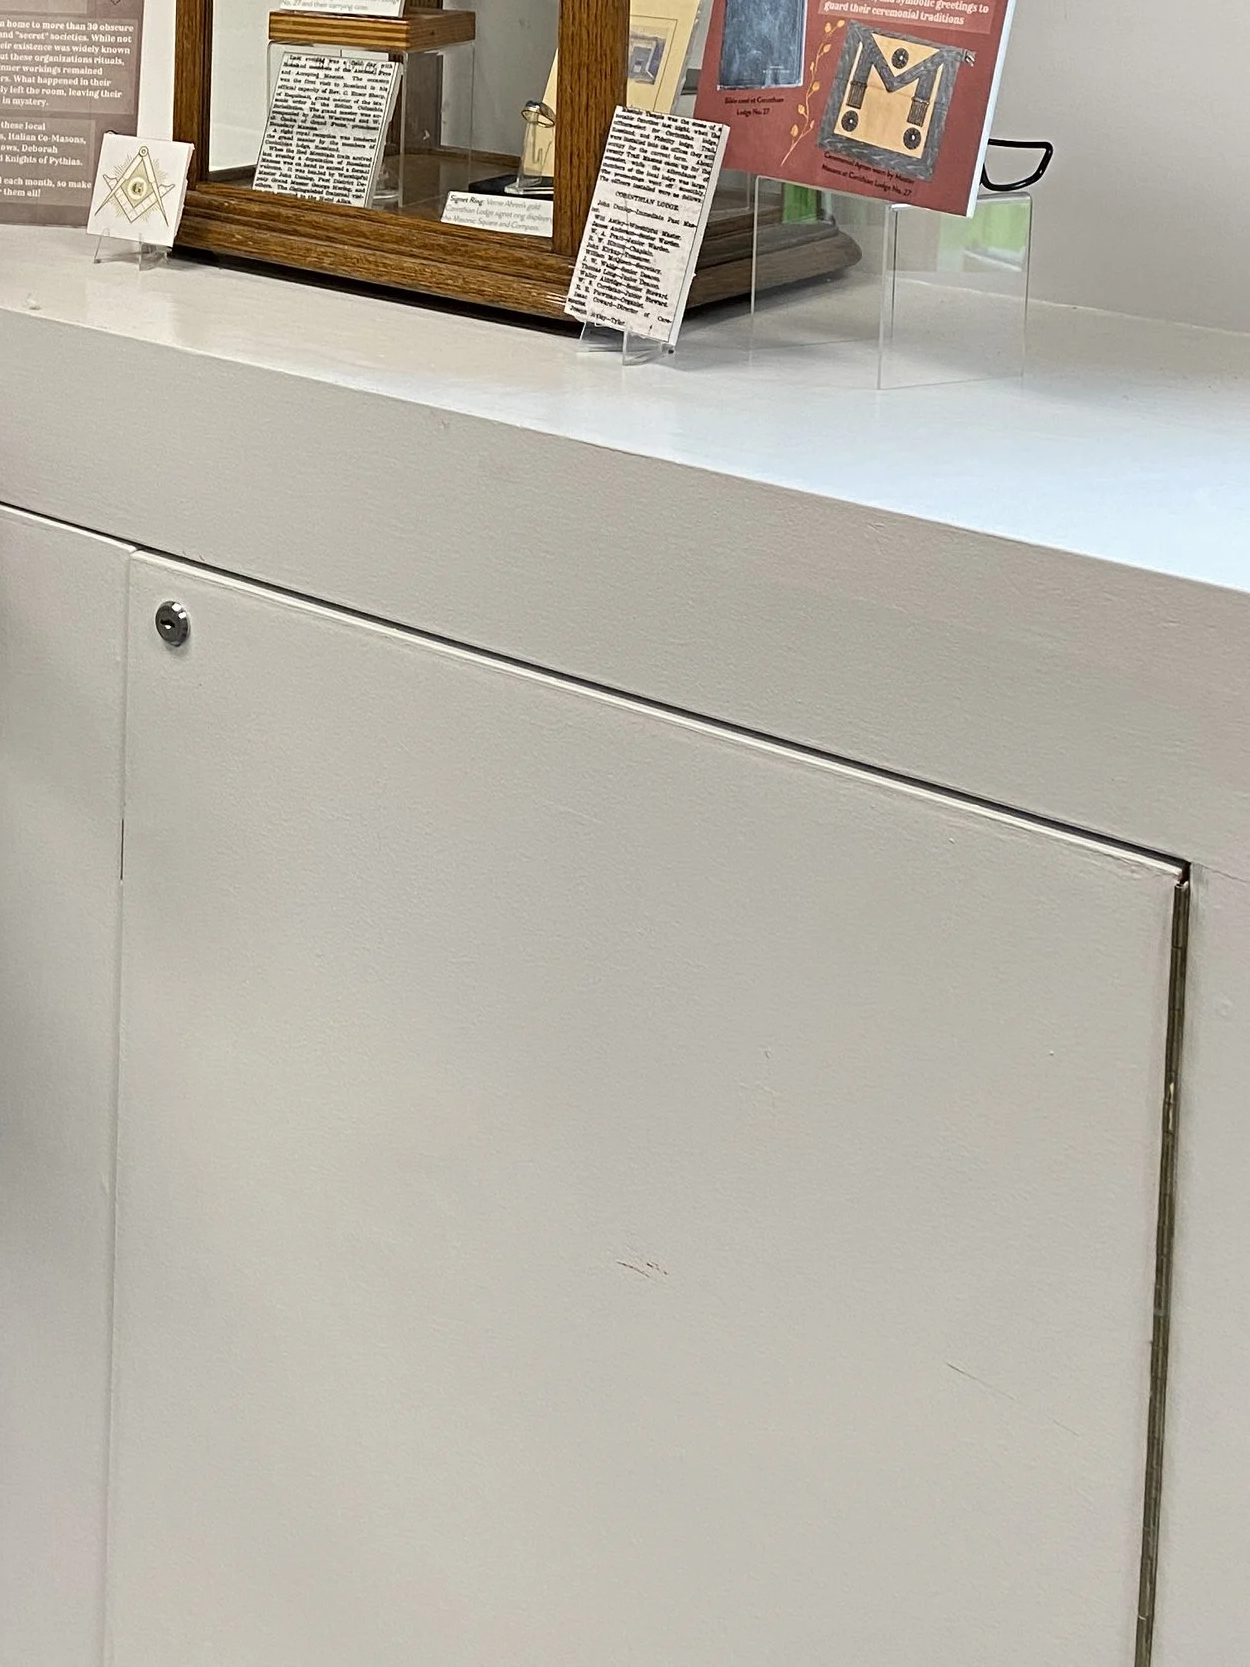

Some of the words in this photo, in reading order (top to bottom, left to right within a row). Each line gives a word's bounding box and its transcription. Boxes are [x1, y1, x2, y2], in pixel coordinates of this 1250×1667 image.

[824, 0, 849, 14] guard
[848, 3, 871, 15] their
[871, 5, 920, 20] ceremonial
[919, 11, 965, 25] traditions
[978, 3, 990, 13] to
[21, 144, 58, 153] Deborah
